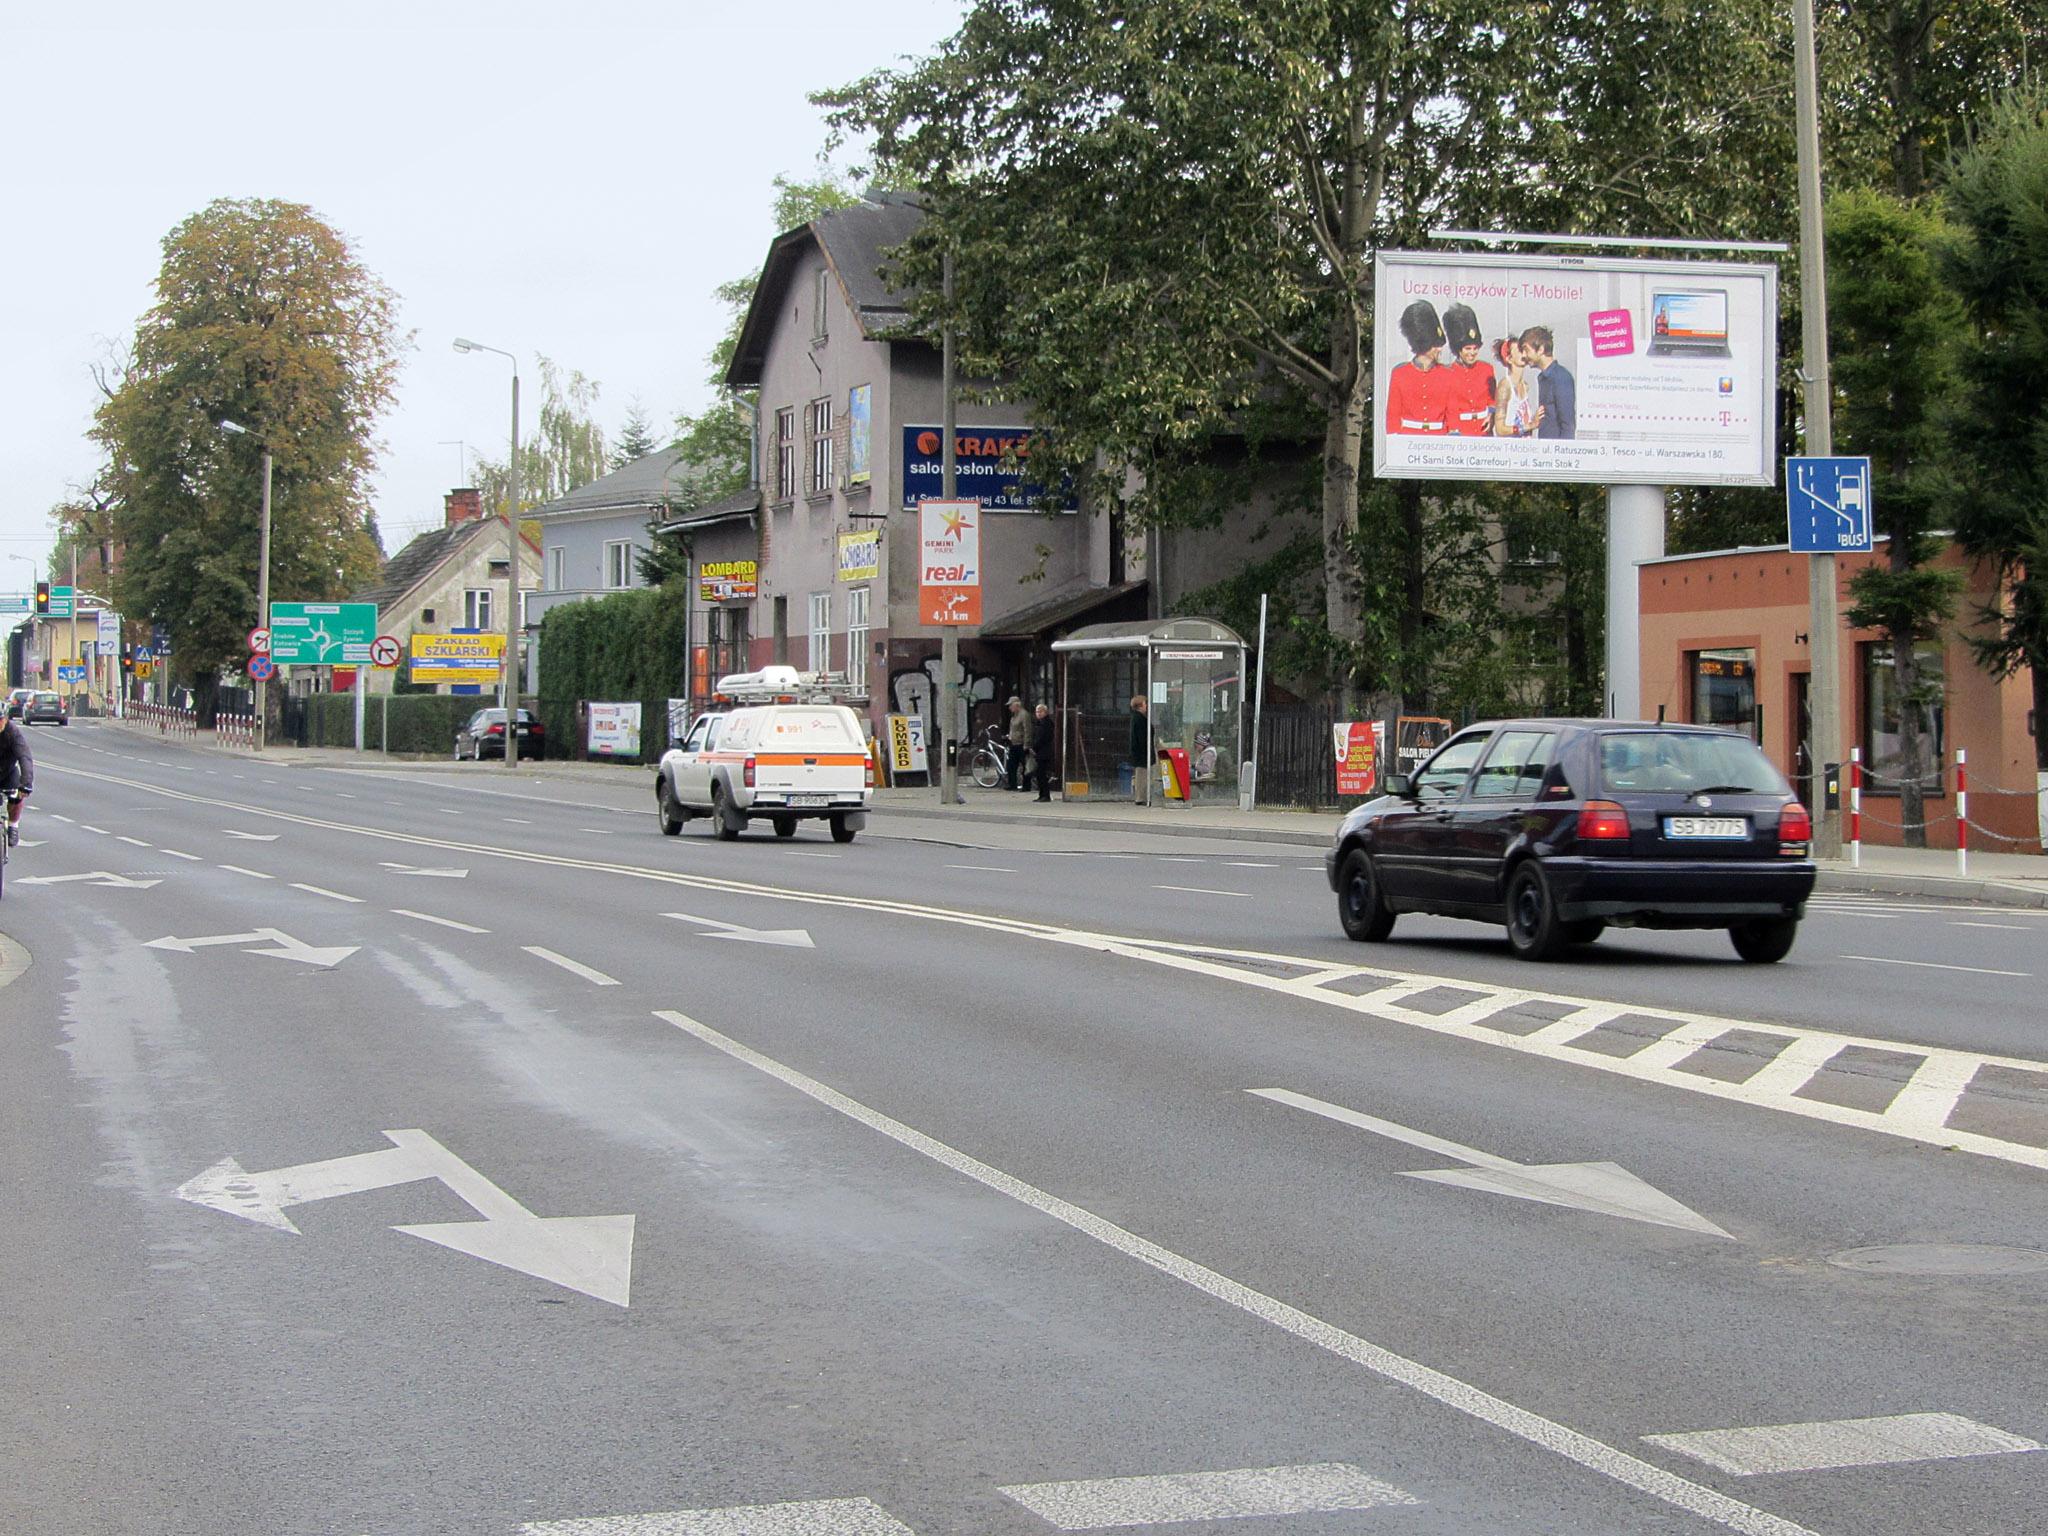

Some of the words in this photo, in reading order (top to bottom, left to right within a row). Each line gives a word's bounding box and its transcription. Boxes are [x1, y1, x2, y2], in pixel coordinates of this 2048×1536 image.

[1402, 279, 1429, 295] Ucz
[1432, 281, 1451, 297] się
[1454, 281, 1508, 299] języków
[1511, 286, 1518, 298] z
[1521, 283, 1584, 300] T-Mobile!
[1457, 443, 1468, 452] do
[1542, 445, 1552, 454] ul.
[1554, 445, 1598, 456] Ratuszowa
[1613, 446, 1636, 457] Tesco
[1645, 448, 1654, 457] ul.
[1657, 448, 1706, 459] Warszawska
[1407, 454, 1421, 464] CH
[1422, 455, 1444, 465] Sarni
[1446, 455, 1464, 465] Stok
[1466, 456, 1512, 467] (Carrefour)
[1520, 457, 1531, 467] ul.
[1532, 458, 1553, 468] Sarni
[1554, 459, 1574, 469] Stok
[1574, 459, 1581, 469] 2
[994, 495, 1007, 504] 43
[925, 540, 954, 548] GEMINI
[1840, 533, 1863, 547] BUS
[840, 543, 879, 569] LOMBARD
[701, 560, 757, 577] LOMBARD
[933, 610, 949, 622] 4,1
[952, 610, 969, 621] km
[425, 645, 490, 656] SZKLARSKI
[894, 719, 910, 767] LOMBARD
[1399, 747, 1418, 758] SALON
[1674, 818, 1695, 835] SB
